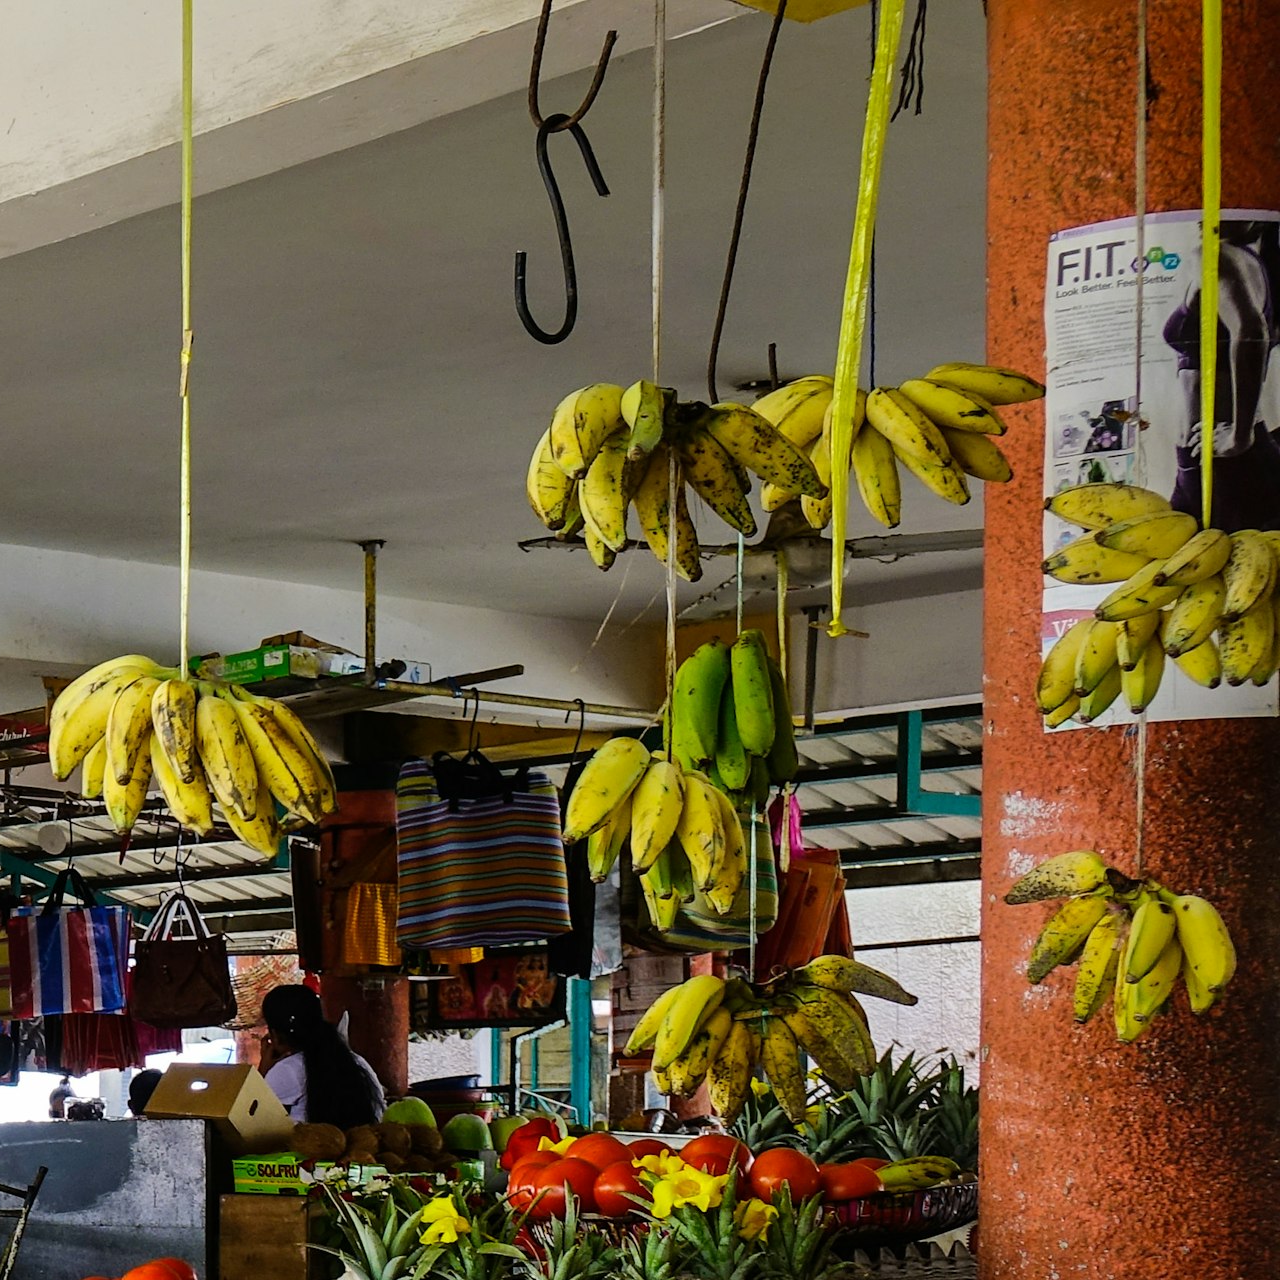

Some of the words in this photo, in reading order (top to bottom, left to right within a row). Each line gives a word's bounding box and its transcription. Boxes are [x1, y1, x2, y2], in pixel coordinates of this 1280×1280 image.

[1057, 241, 1126, 286] F.I.T.
[1056, 287, 1078, 299] Look
[1082, 281, 1114, 294] Better.
